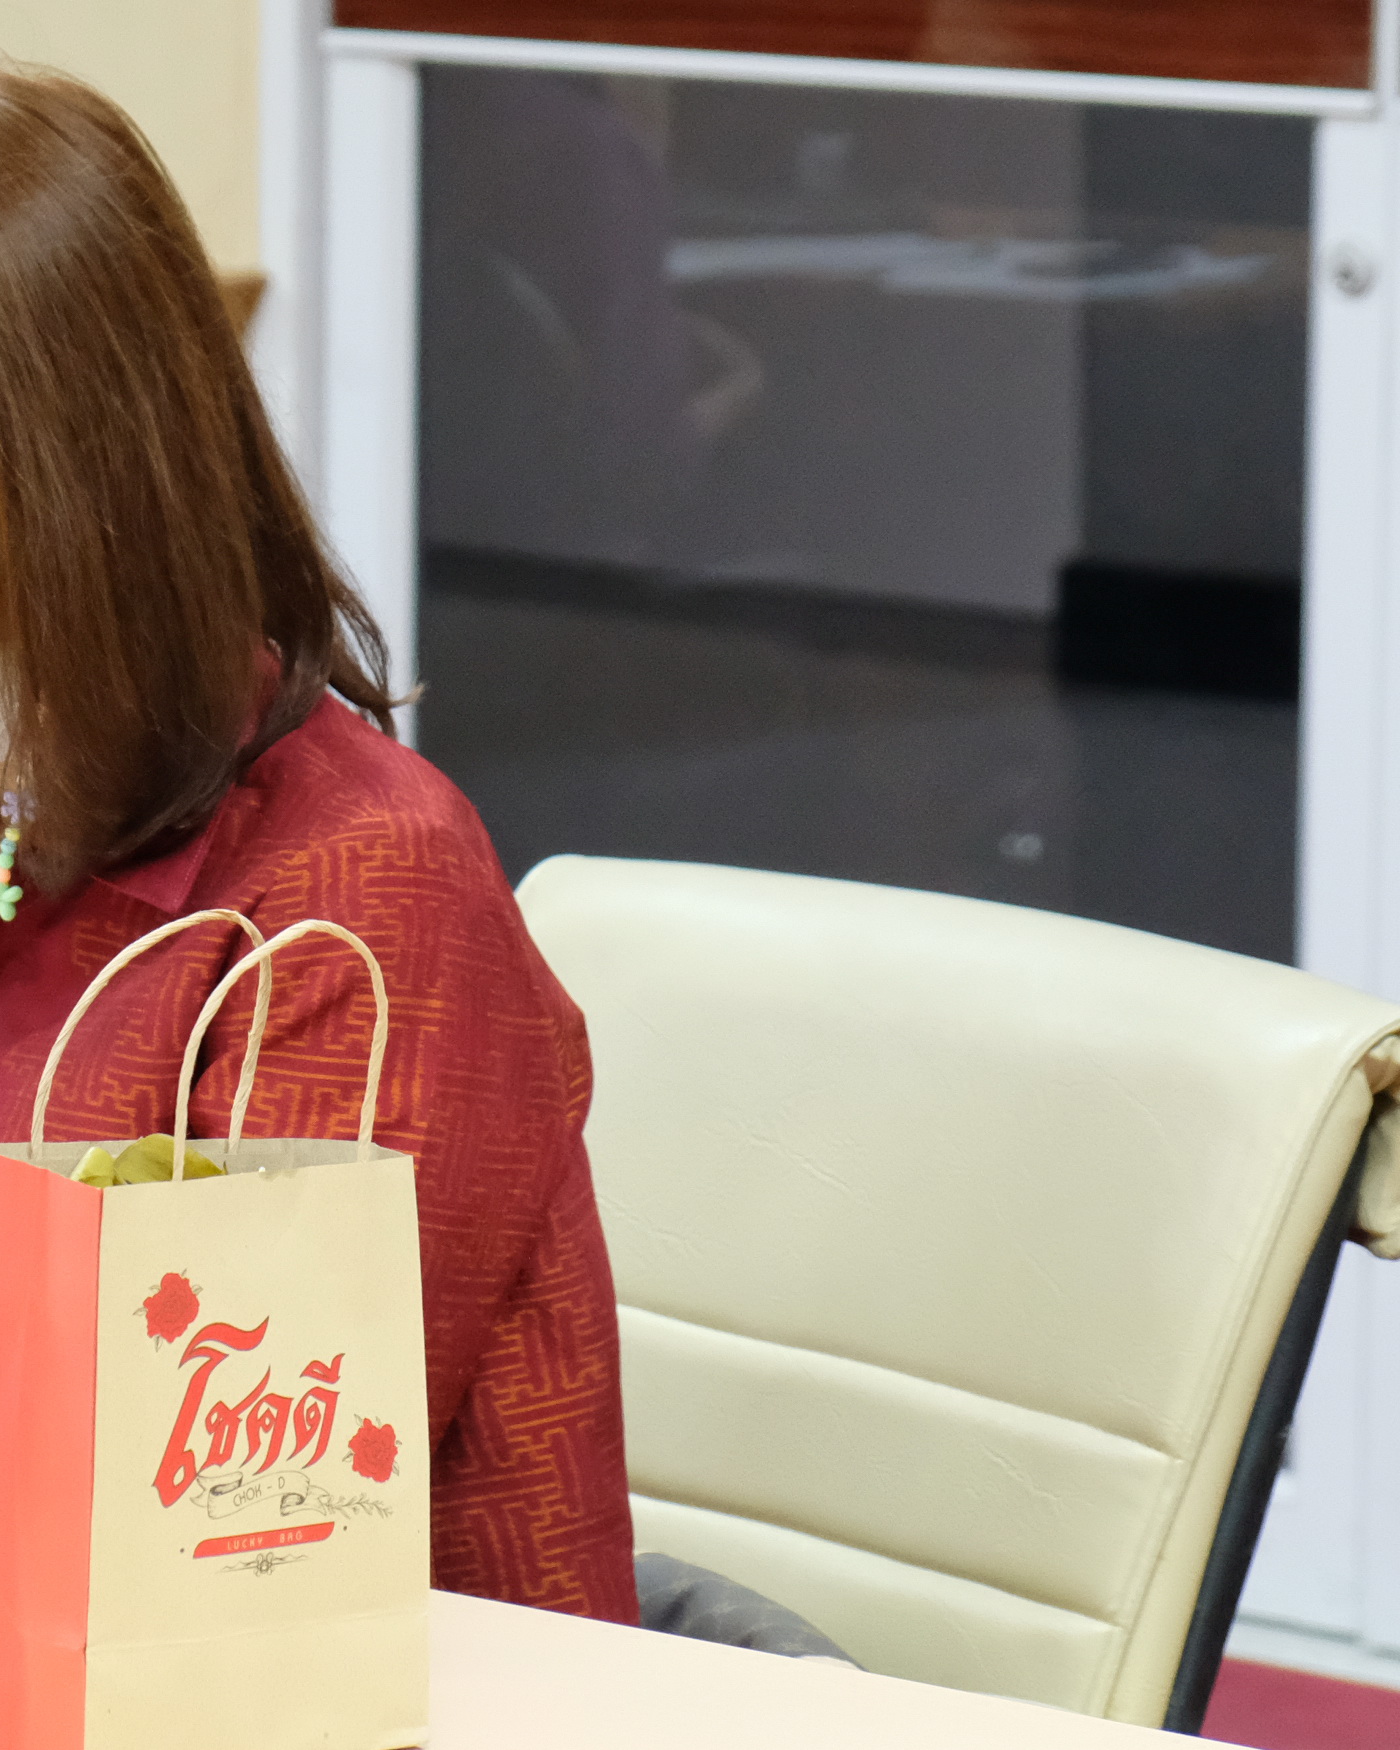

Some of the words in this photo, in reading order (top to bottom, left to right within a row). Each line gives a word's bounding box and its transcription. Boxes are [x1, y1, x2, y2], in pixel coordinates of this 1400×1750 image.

[151, 1315, 346, 1508] โชคดี
[233, 1484, 262, 1507] CHOK
[227, 1537, 263, 1551] LUCKY
